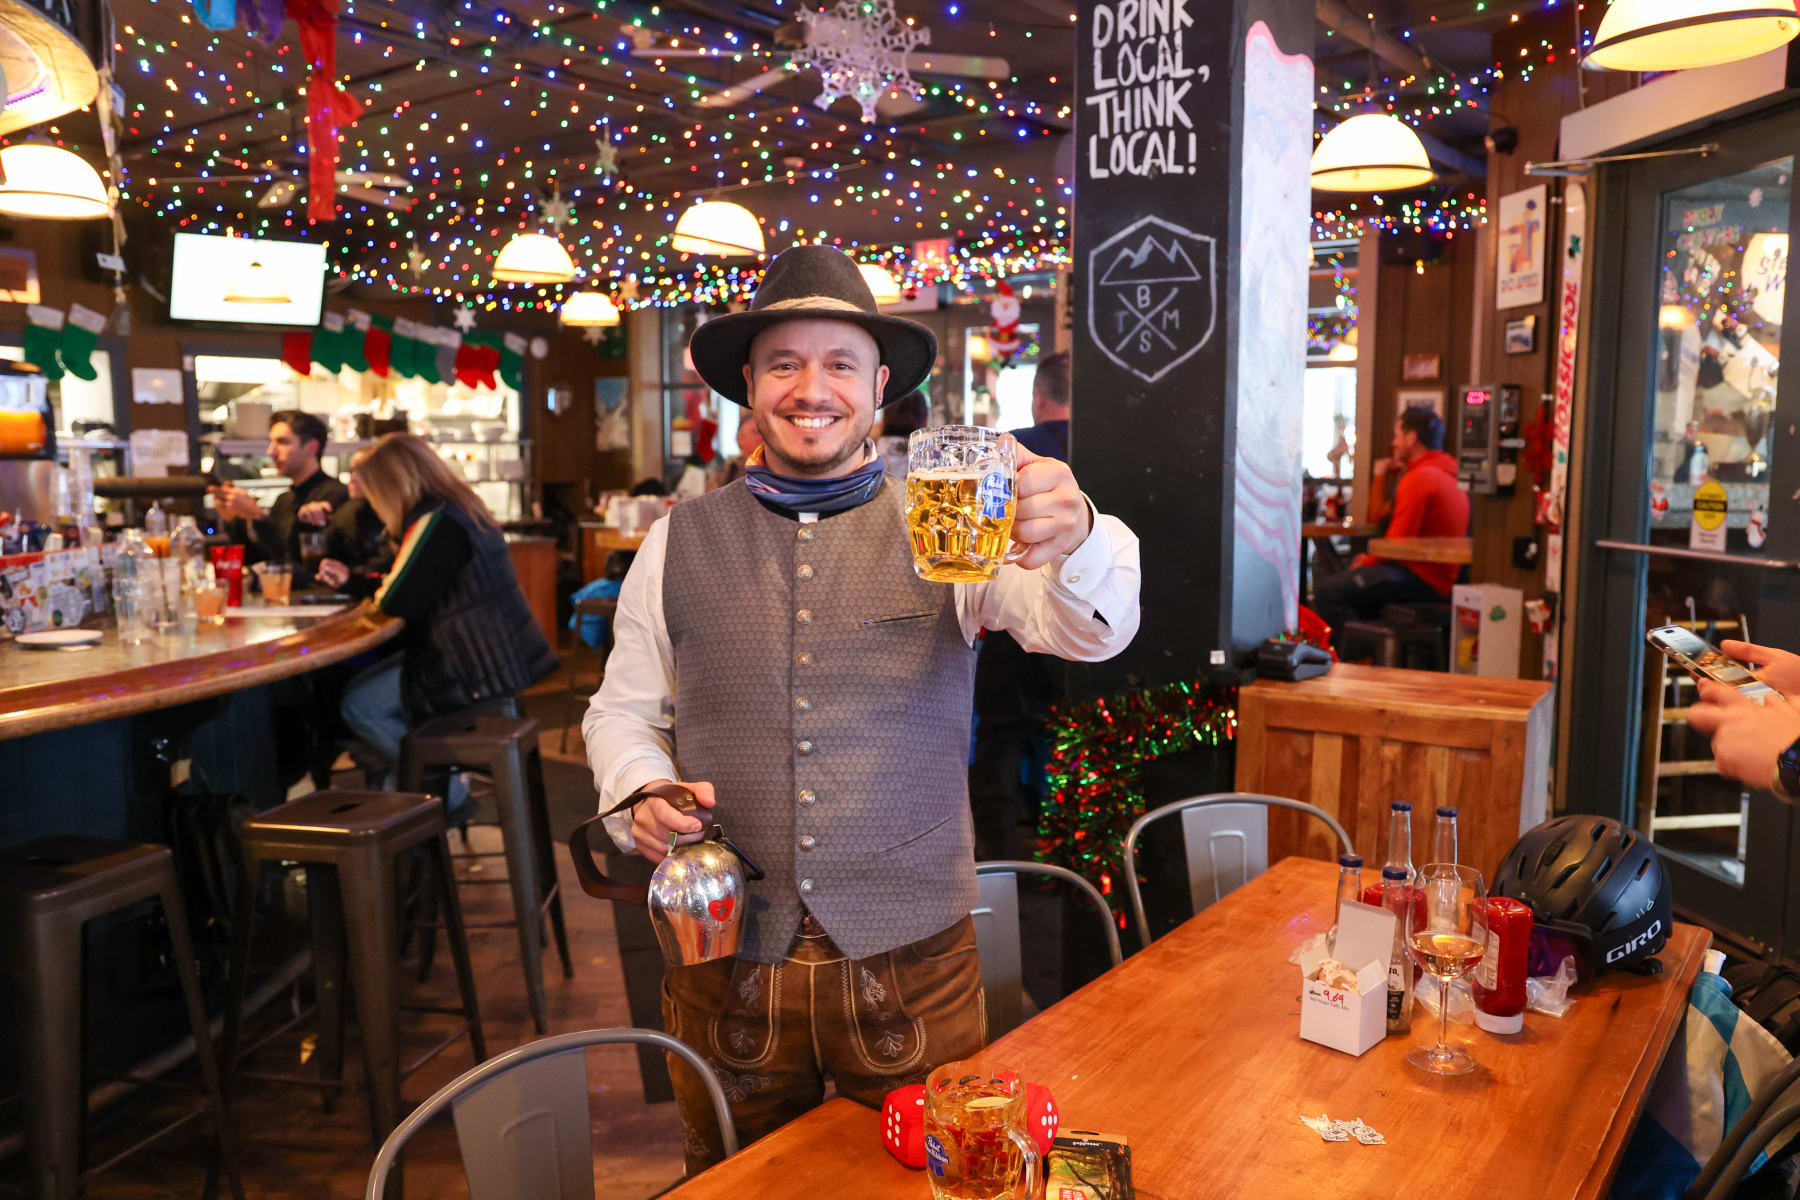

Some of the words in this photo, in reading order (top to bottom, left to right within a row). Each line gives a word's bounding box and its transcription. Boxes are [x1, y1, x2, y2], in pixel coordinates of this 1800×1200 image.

[1093, 0, 1195, 48] DRINK
[1093, 30, 1210, 90] LOCAL,
[1086, 80, 1194, 138] THINK
[1089, 130, 1197, 179] LOCAL!
[1137, 285, 1150, 308] B
[1115, 311, 1129, 333] T
[1162, 309, 1180, 331] M
[1139, 330, 1151, 353] S
[1606, 919, 1662, 964] GIRO
[1323, 989, 1344, 1005] 9.69
